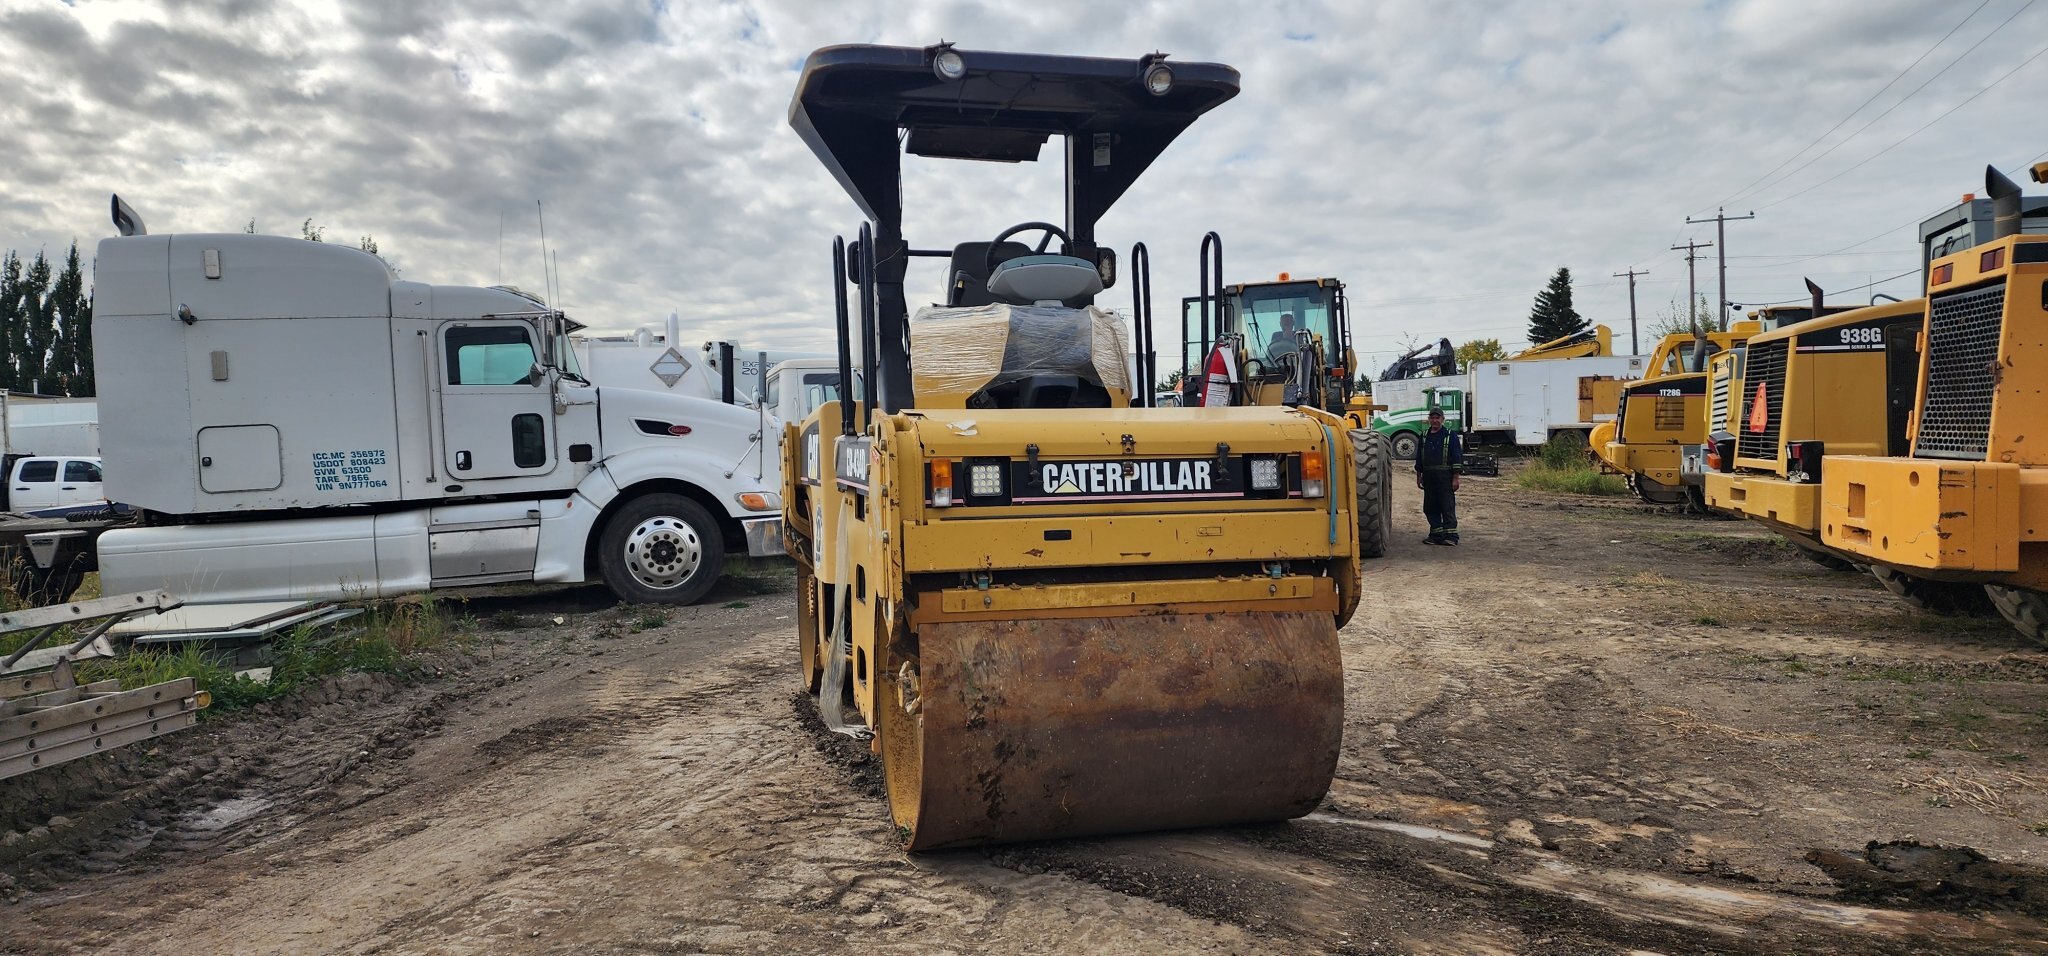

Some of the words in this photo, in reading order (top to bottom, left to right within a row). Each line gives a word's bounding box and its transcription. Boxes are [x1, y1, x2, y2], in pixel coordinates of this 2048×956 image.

[1840, 328, 1881, 343] 938G
[1416, 359, 1434, 369] DEERE
[313, 452, 345, 460] ICC.MC
[350, 450, 385, 458] 356972
[313, 460, 344, 468] USDOT
[350, 458, 386, 466] 808423
[314, 468, 336, 476] GVW
[1042, 460, 1212, 494] CATERPILLAR
[315, 475, 340, 483] TARE
[345, 474, 369, 482] 7866
[316, 483, 333, 491] VIN
[338, 480, 387, 489] 9N777064
